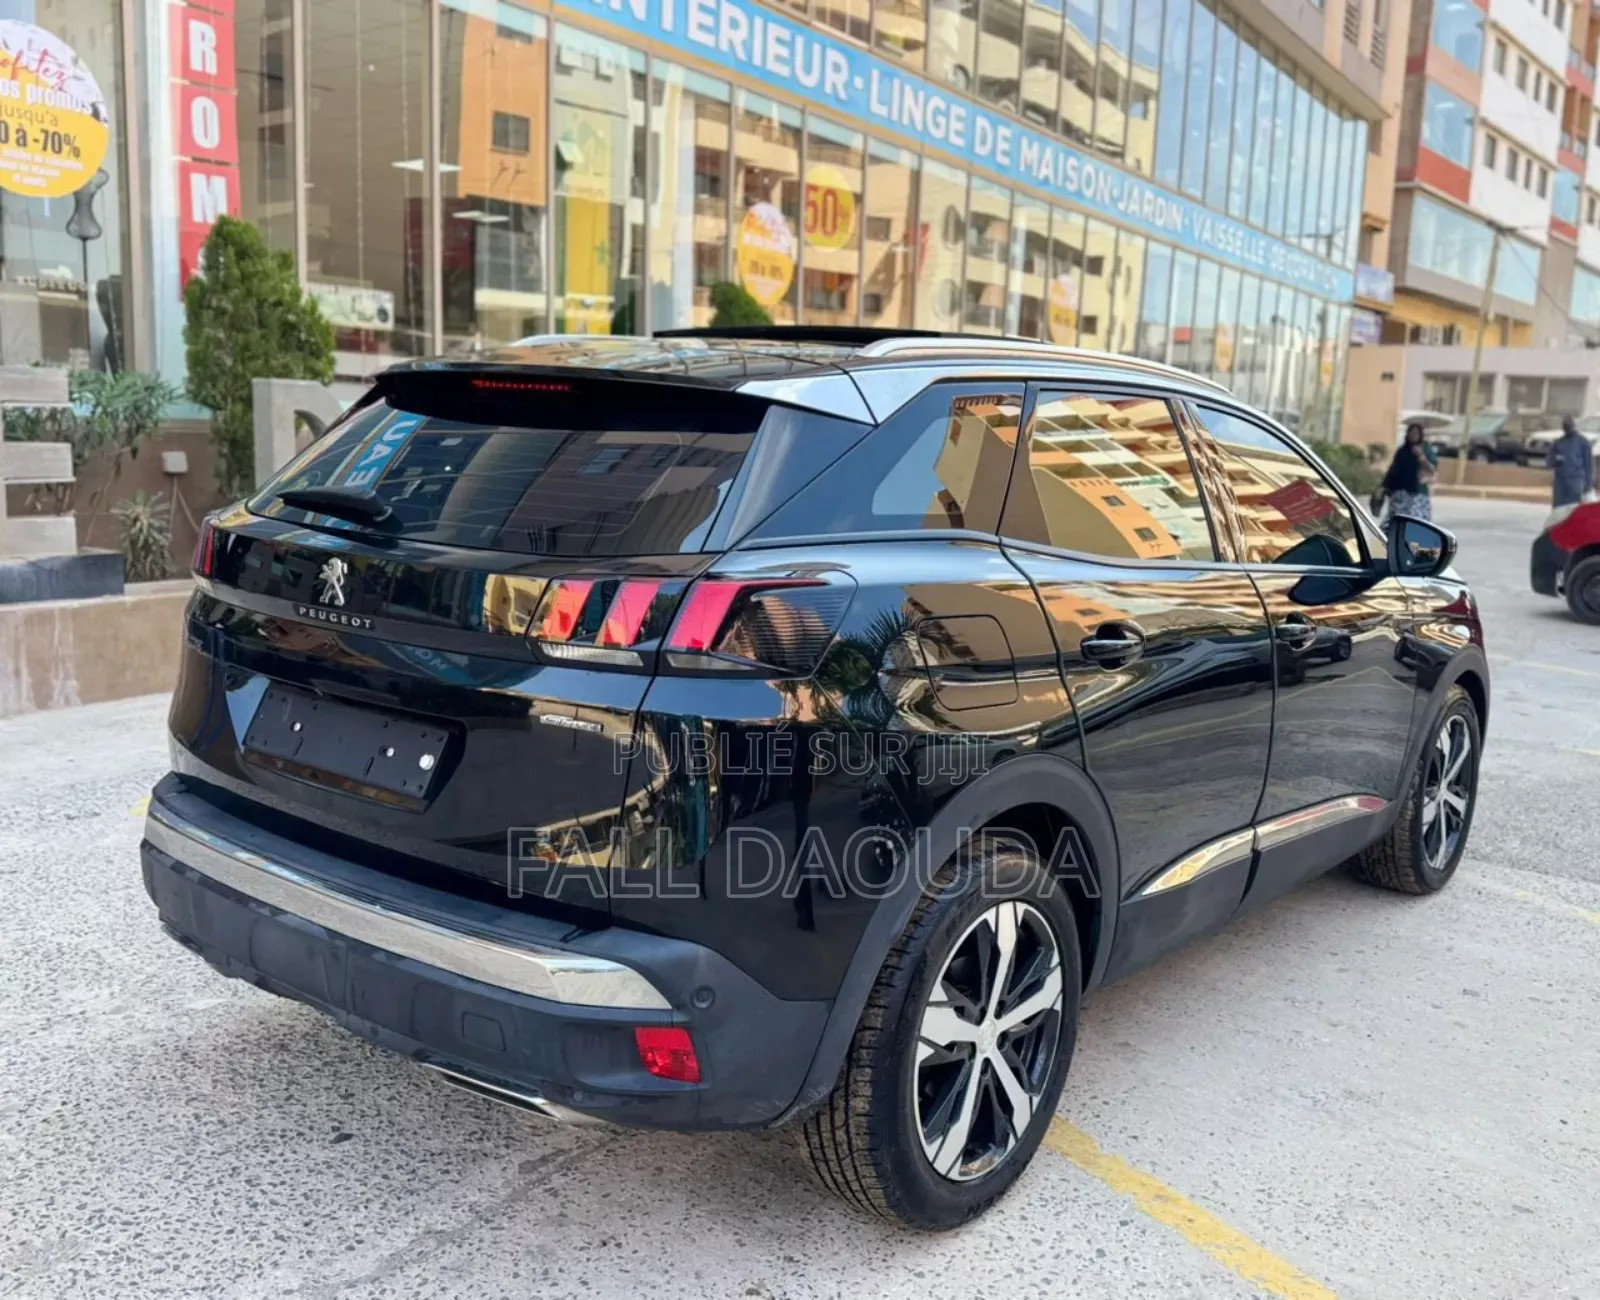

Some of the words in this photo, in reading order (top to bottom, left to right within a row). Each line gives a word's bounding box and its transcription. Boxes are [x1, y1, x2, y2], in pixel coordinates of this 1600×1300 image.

[32, 127, 81, 159] -70%
[592, 0, 850, 101] TERIEUR
[868, 67, 968, 149] LINGE
[973, 114, 1013, 166] DE
[1192, 211, 1267, 266] VAISSELLE
[298, 606, 373, 629] PEUGEOT
